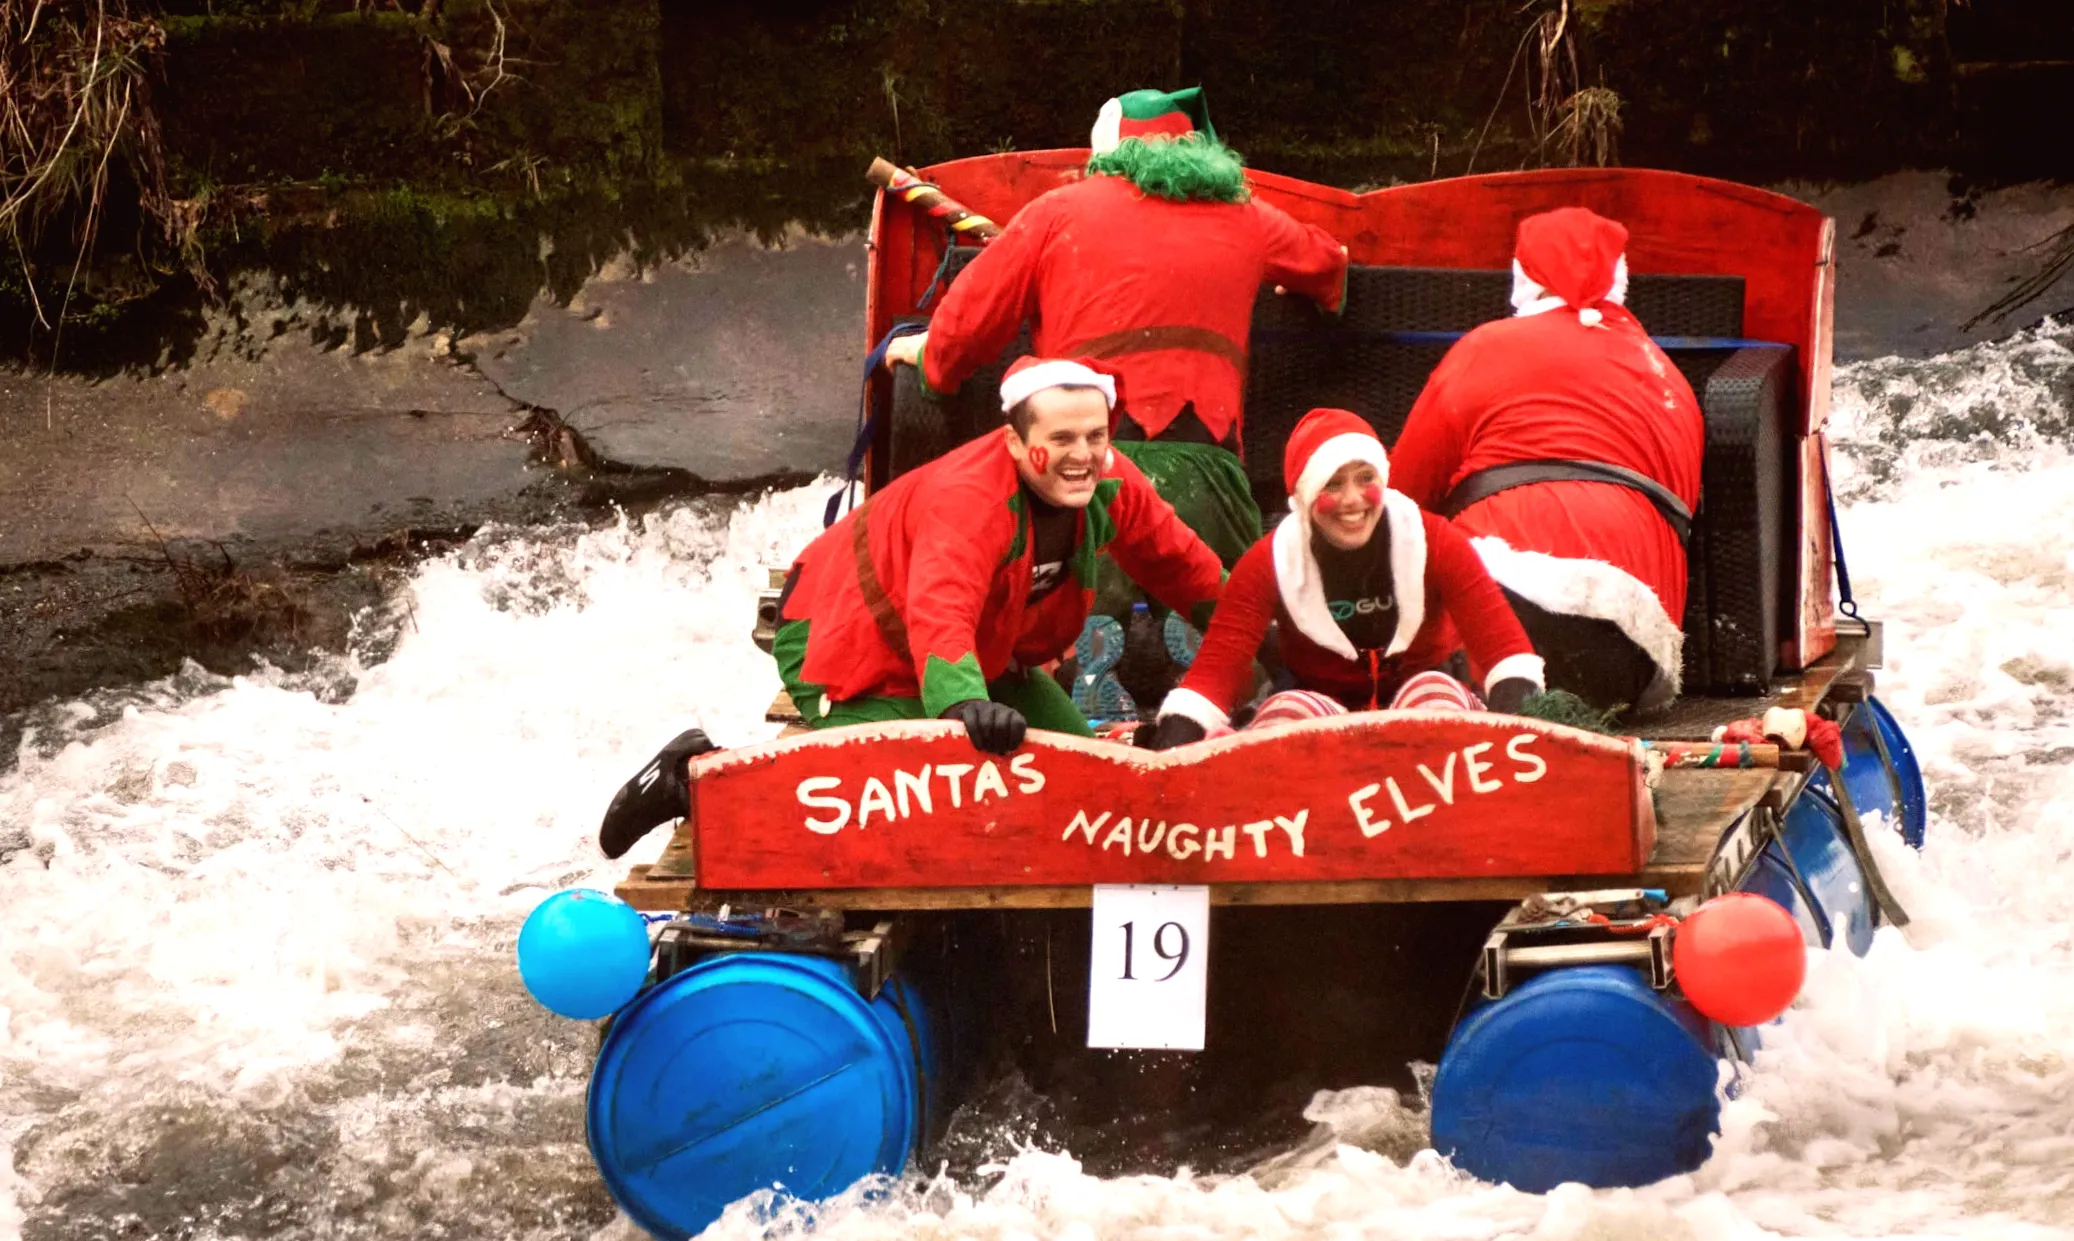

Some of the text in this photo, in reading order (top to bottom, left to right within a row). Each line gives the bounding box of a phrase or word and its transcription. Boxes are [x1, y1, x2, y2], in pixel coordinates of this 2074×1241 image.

[796, 733, 1548, 862] SANTAS NAUGHTY ELVES
[1115, 920, 1190, 983] 19
